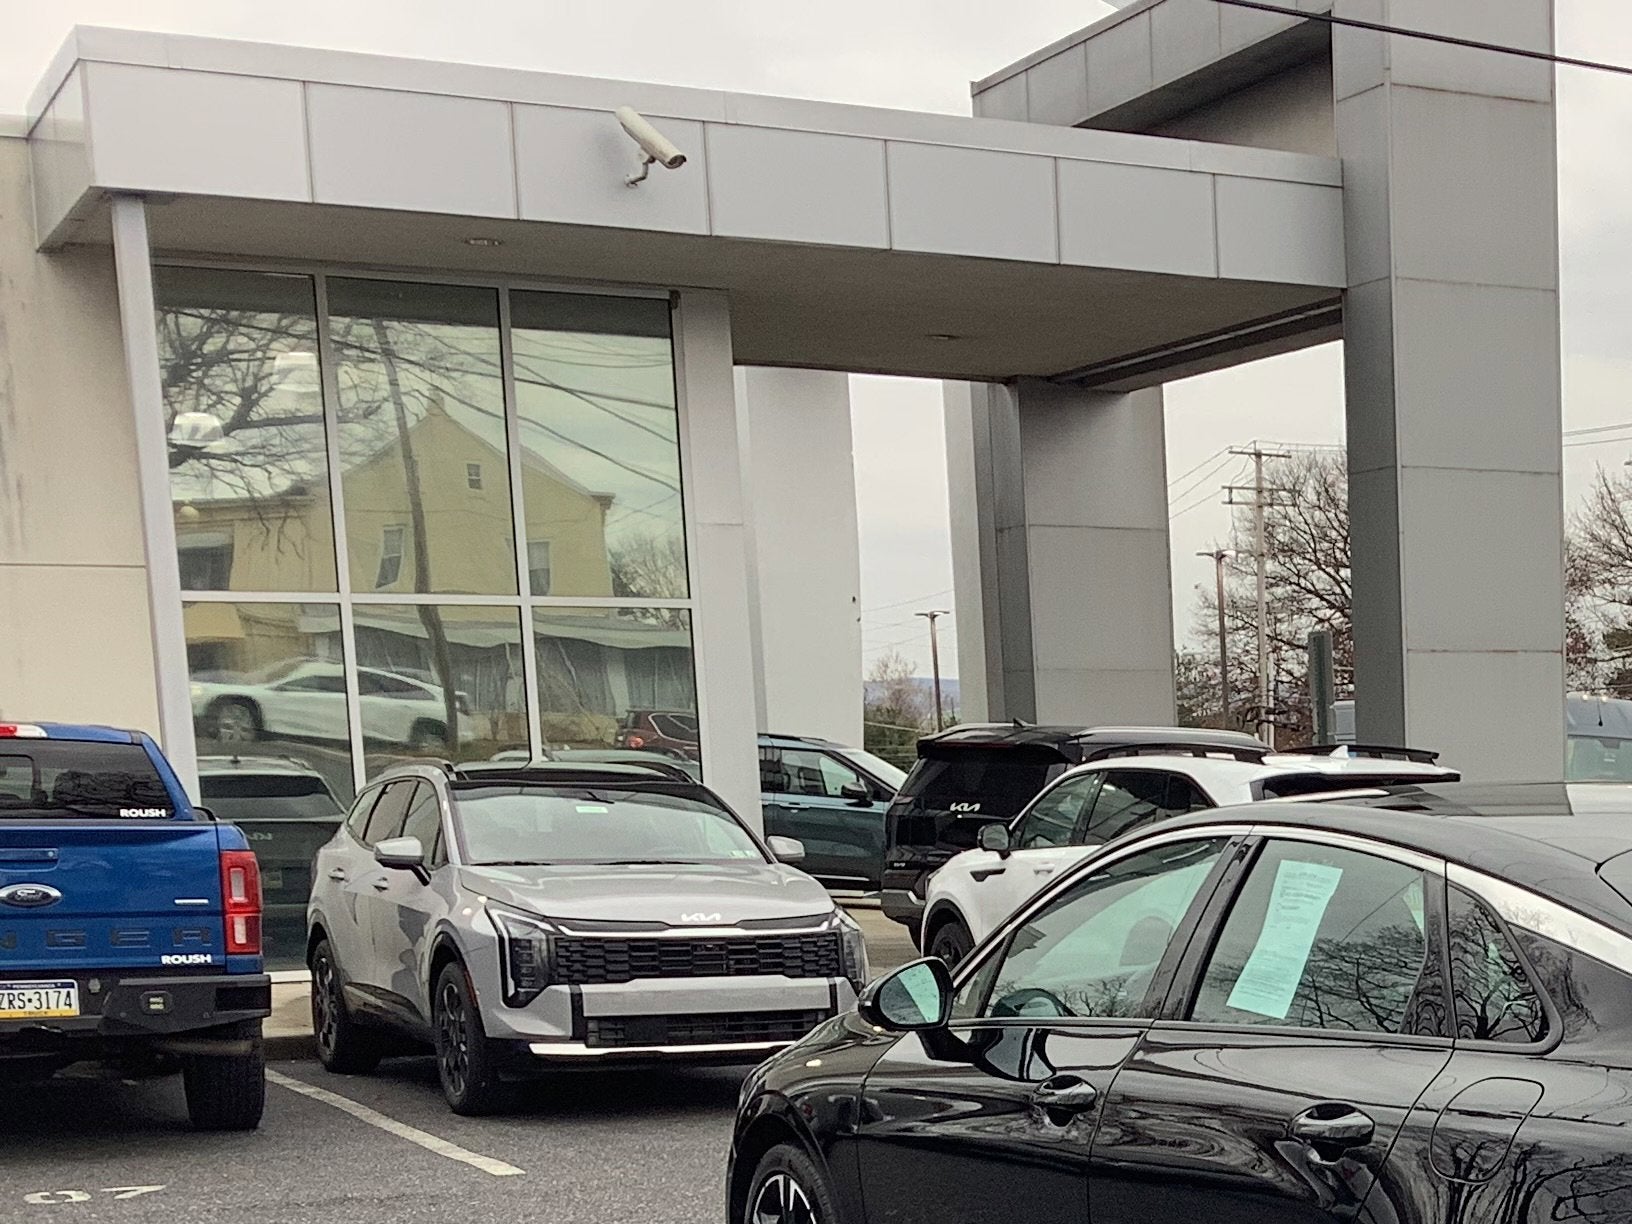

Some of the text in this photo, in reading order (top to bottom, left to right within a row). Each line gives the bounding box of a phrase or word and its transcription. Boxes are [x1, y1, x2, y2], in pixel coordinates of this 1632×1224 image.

[949, 802, 980, 812] KIA
[120, 808, 166, 818] ROUSH
[681, 912, 721, 921] KIA
[161, 954, 212, 965] ROUSH
